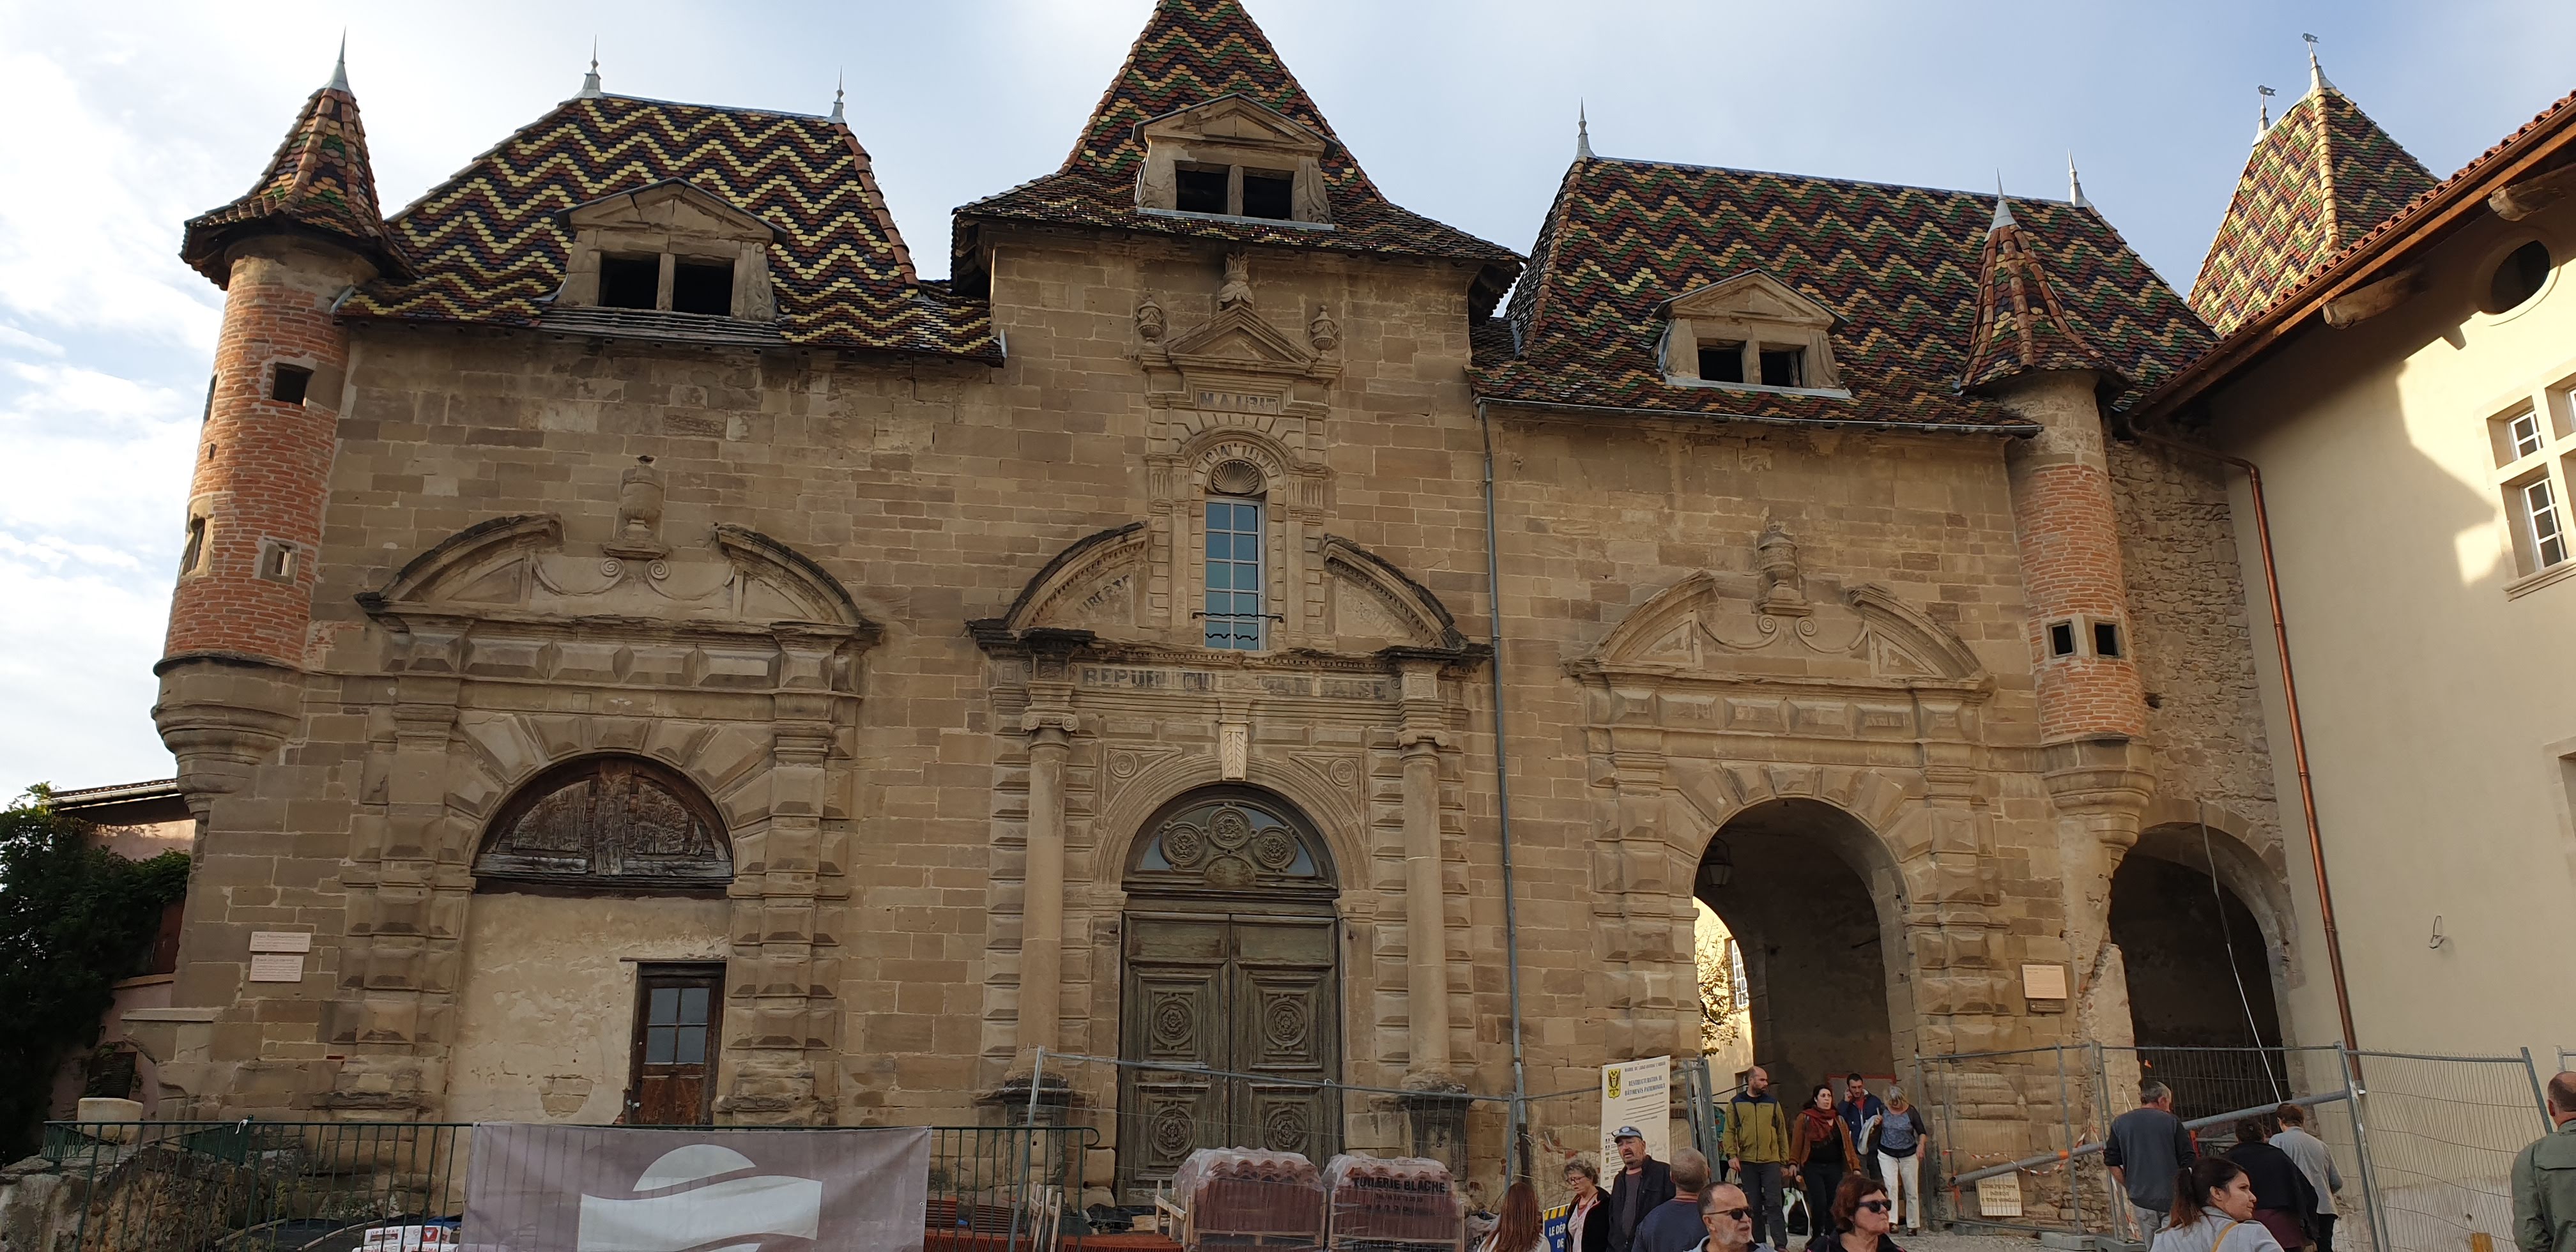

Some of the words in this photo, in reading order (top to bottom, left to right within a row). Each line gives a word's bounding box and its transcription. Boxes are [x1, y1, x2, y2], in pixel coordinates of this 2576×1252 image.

[1549, 1226, 1555, 1237] LE
[1556, 1222, 1566, 1235] DÉP
[1557, 1238, 1565, 1248] DE
